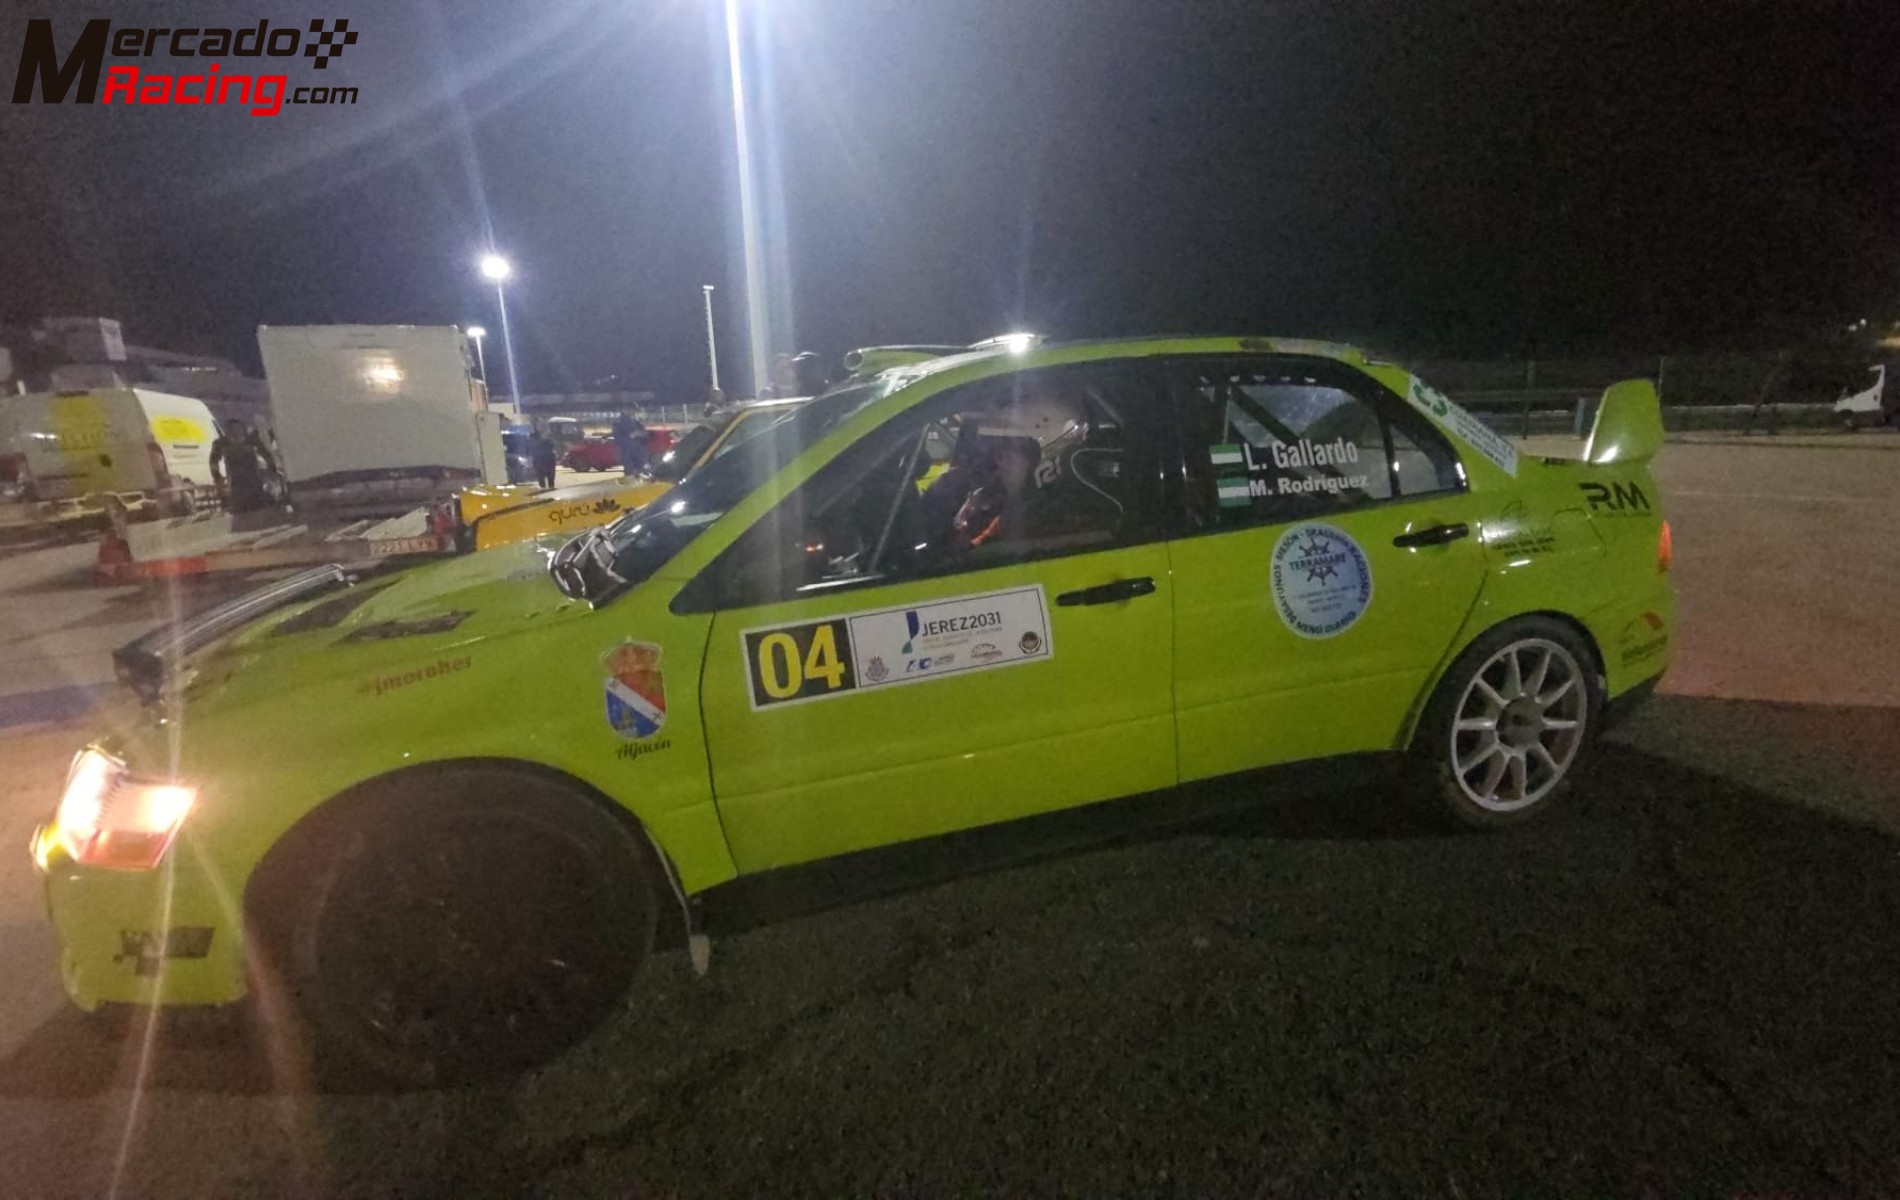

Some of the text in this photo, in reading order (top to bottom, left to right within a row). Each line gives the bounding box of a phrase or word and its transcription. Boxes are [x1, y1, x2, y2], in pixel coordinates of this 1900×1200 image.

[1244, 436, 1359, 471] L. Gallardo
[1250, 479, 1273, 497] M.
[1579, 481, 1651, 511] RM
[1289, 551, 1347, 571] TERRAMARE
[922, 610, 1001, 637] JEREZ2031
[758, 624, 845, 699] 04
